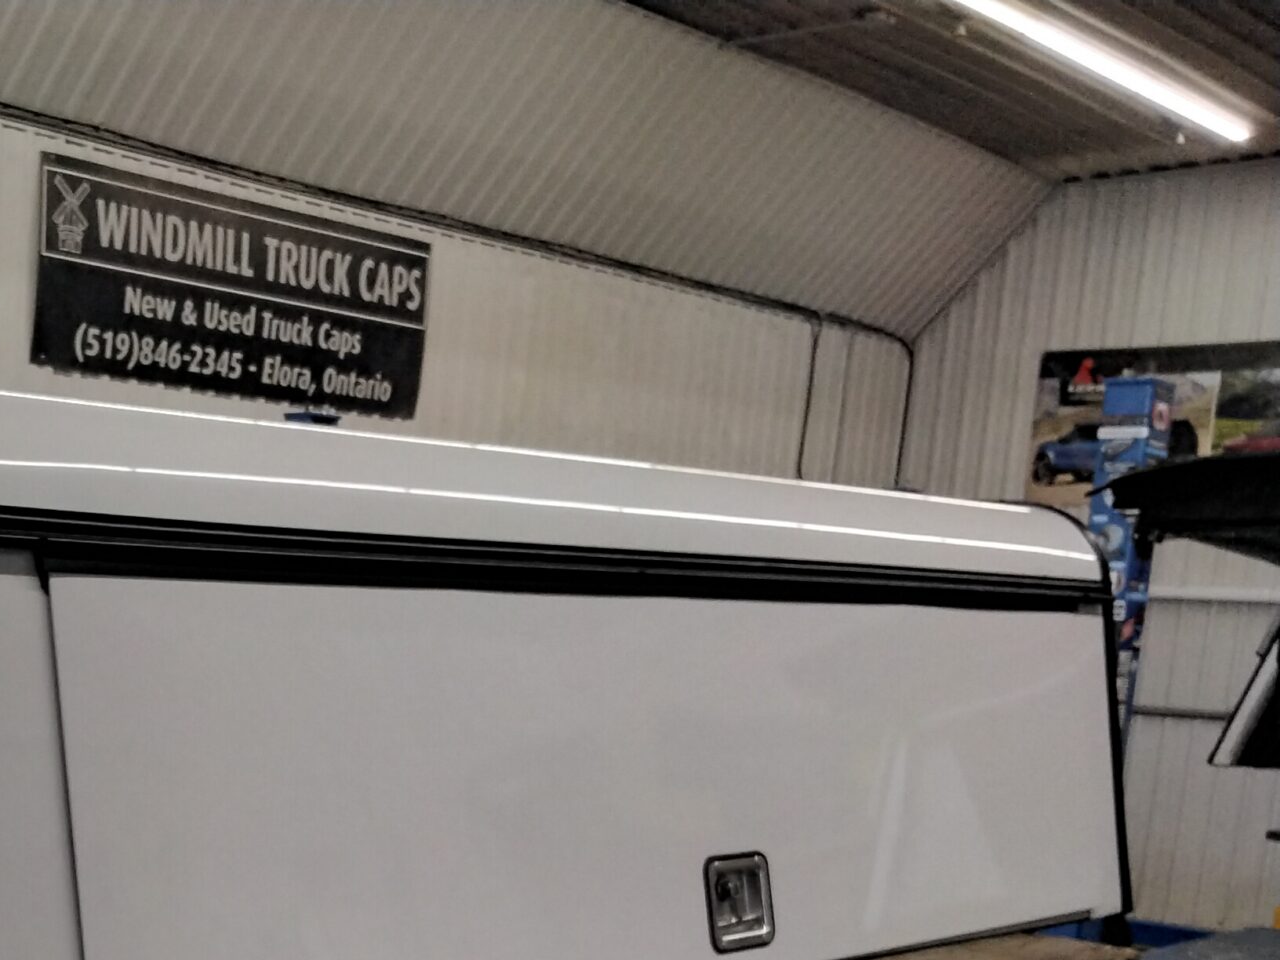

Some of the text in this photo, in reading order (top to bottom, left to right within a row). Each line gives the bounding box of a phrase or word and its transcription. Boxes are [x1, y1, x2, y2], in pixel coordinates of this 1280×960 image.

[95, 197, 422, 312] WINDMILL TRUCK CAPS
[74, 322, 243, 380] (519)846-2345
[261, 356, 316, 397] Elora,
[323, 368, 393, 403] Ontario
[123, 285, 362, 360] New & Used Truck Caps
